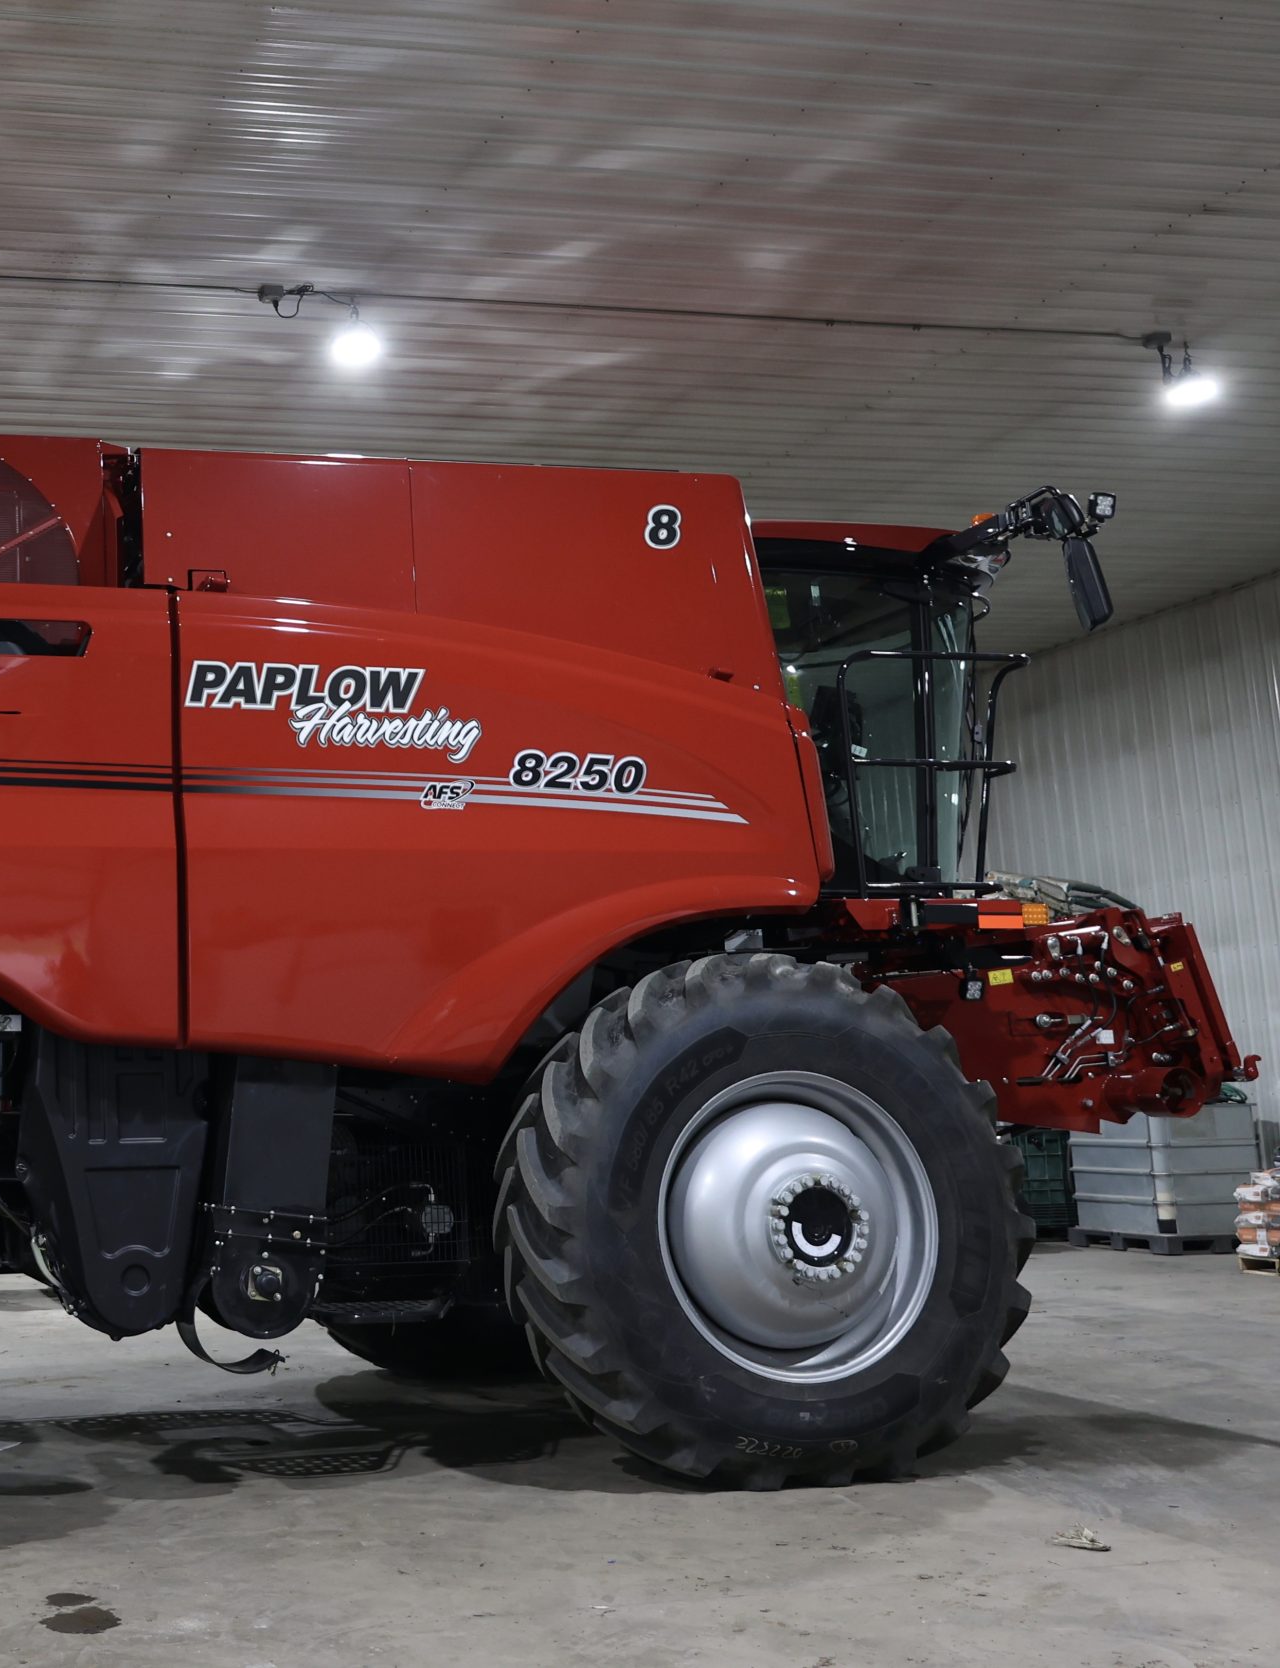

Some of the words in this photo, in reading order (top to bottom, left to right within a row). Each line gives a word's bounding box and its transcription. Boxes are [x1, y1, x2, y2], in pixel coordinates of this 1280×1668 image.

[645, 504, 682, 549] 8
[185, 661, 426, 713] PAPLOW
[290, 701, 482, 763] Harvesting
[421, 784, 463, 801] AFS
[509, 749, 648, 795] 8250
